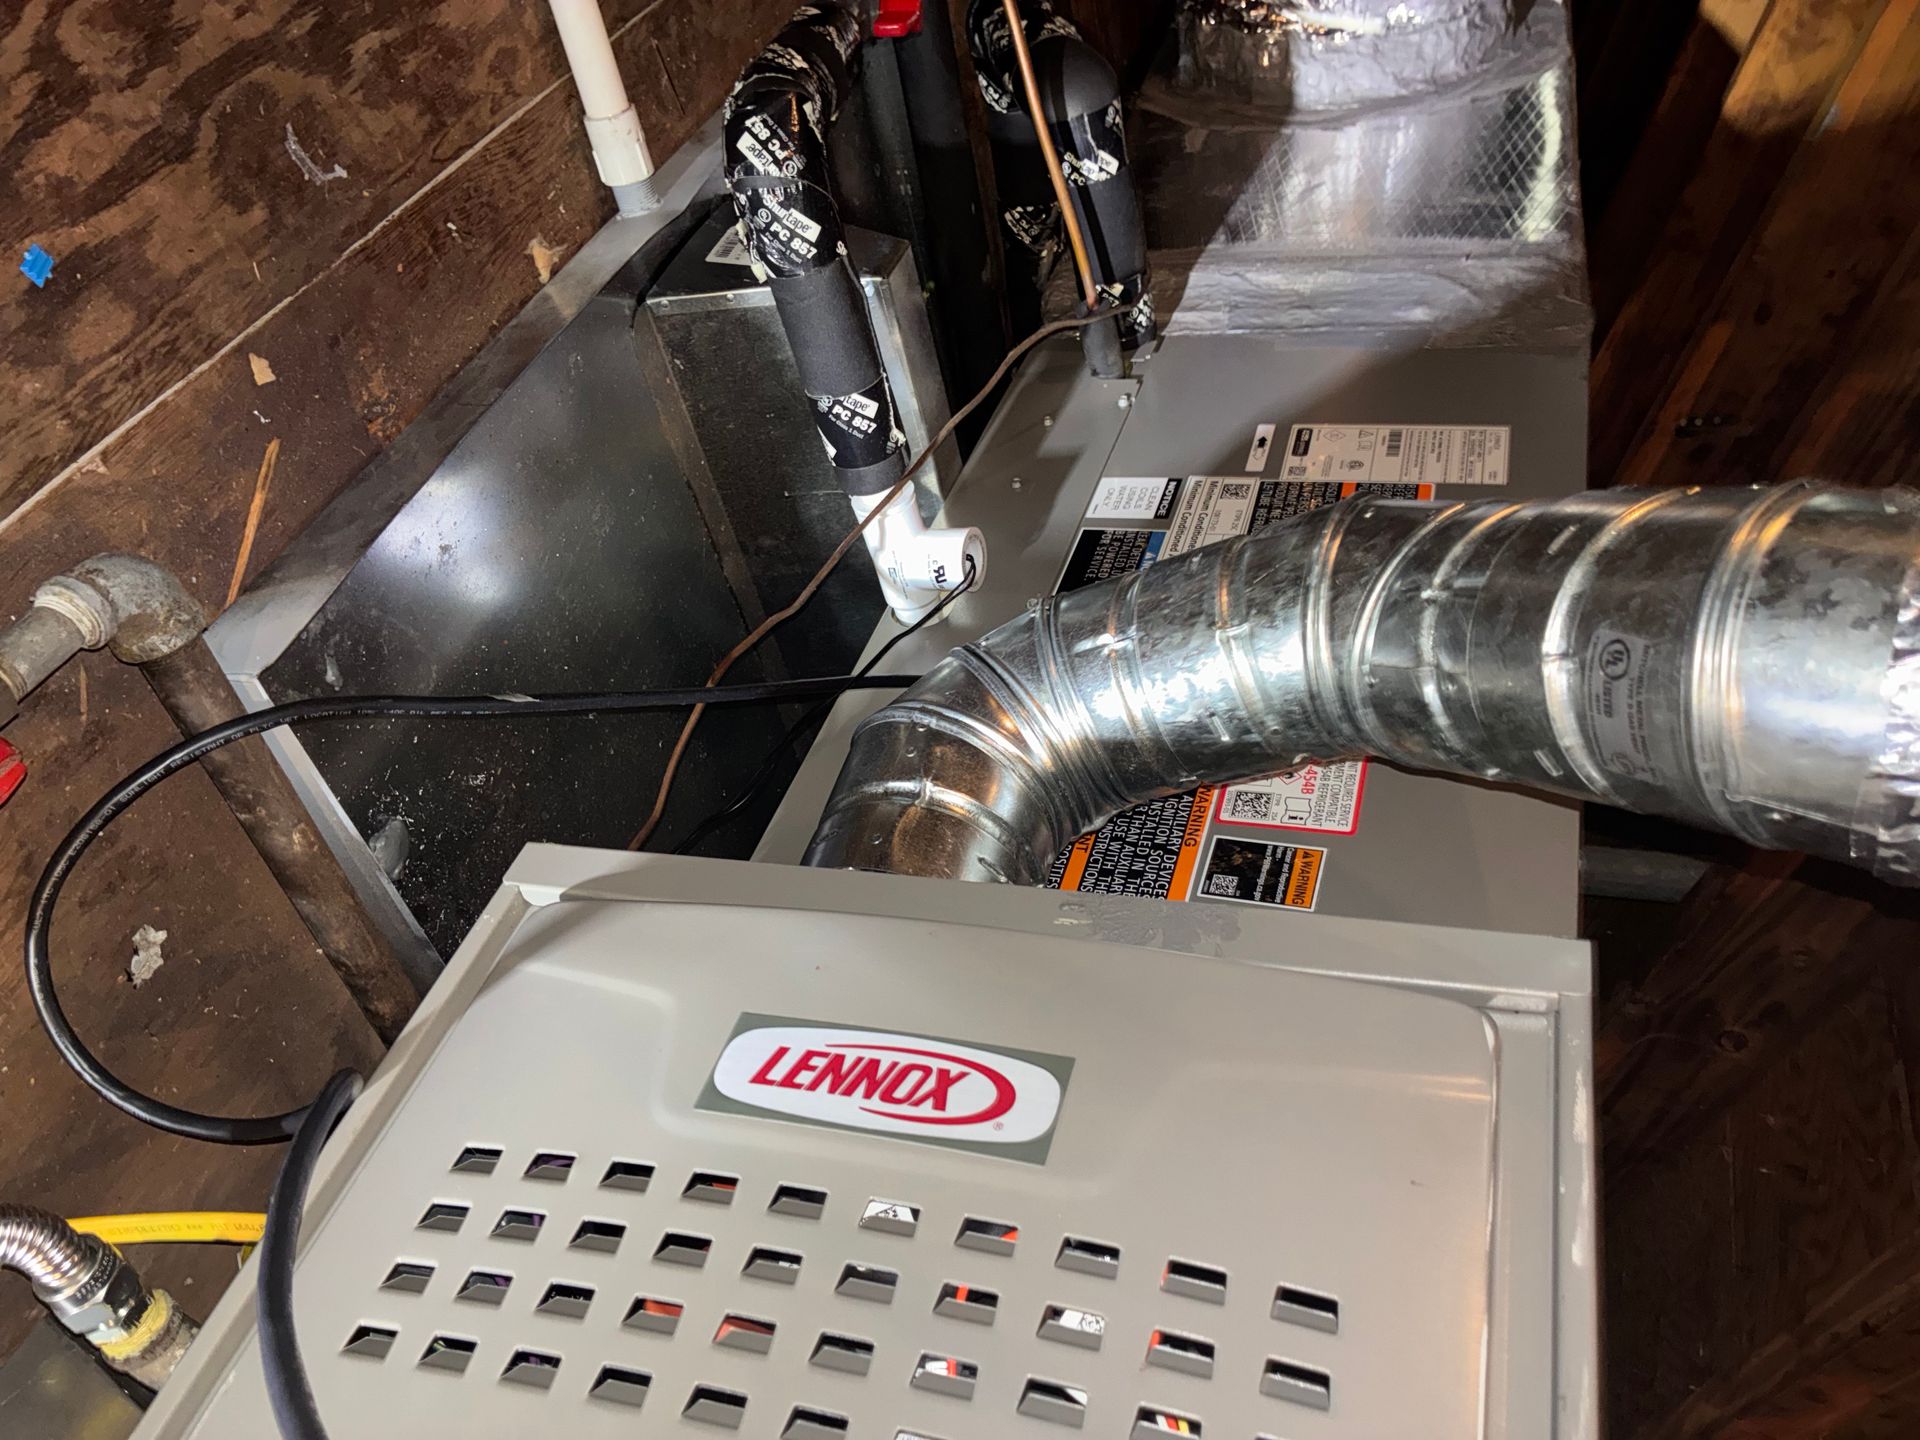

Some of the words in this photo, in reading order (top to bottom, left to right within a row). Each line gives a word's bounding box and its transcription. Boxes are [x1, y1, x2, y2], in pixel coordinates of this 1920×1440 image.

[768, 139, 787, 160] PC
[770, 222, 790, 241] PC
[790, 237, 818, 259] 857
[832, 404, 852, 421] PC
[852, 415, 877, 433] 857
[1103, 487, 1115, 507] ONLY
[1111, 485, 1127, 510] WATER
[1122, 487, 1138, 509] USING
[1134, 487, 1149, 509] COILS
[1145, 487, 1160, 510] CLEAN
[1157, 481, 1178, 516] NOTICE
[1183, 480, 1203, 510] Minimum
[1201, 481, 1219, 511] Minimum
[1099, 531, 1113, 545] FOR
[1170, 511, 1192, 552] Conditioned
[1188, 512, 1208, 551] Conditione
[1084, 546, 1107, 580] SERVICE.
[1098, 542, 1120, 578] POWERED
[1126, 548, 1141, 572] DETECT
[1603, 680, 1613, 718] LISTED
[119, 768, 166, 802] SUNLIGHT
[170, 737, 227, 769] RESISTANT
[231, 730, 244, 740] OR
[304, 709, 351, 720] LOCATION
[1342, 771, 1357, 800] REQUIRES
[1185, 785, 1212, 847] WARNING
[1312, 783, 1329, 827] REFRIGERANT
[1325, 784, 1342, 823] COMPATIBLE
[1337, 801, 1353, 827] SERVICE
[1112, 818, 1130, 838] USE
[1125, 813, 1146, 843] THAN
[1154, 798, 1179, 844] IGNITION
[1167, 795, 1193, 852] AUXILIARY
[1080, 823, 1114, 892] INSTRUCTIONS
[1102, 841, 1123, 869] WITH
[1131, 858, 1147, 870] IN
[1276, 847, 1285, 859] Harm
[1282, 863, 1290, 873] and
[1285, 848, 1294, 863] Cancer
[1094, 876, 1111, 894] THE
[1123, 878, 1141, 897] THE
[1275, 872, 1288, 903] Reproductive
[1292, 861, 1313, 905] WARNING
[748, 1046, 971, 1112] LENNOX
